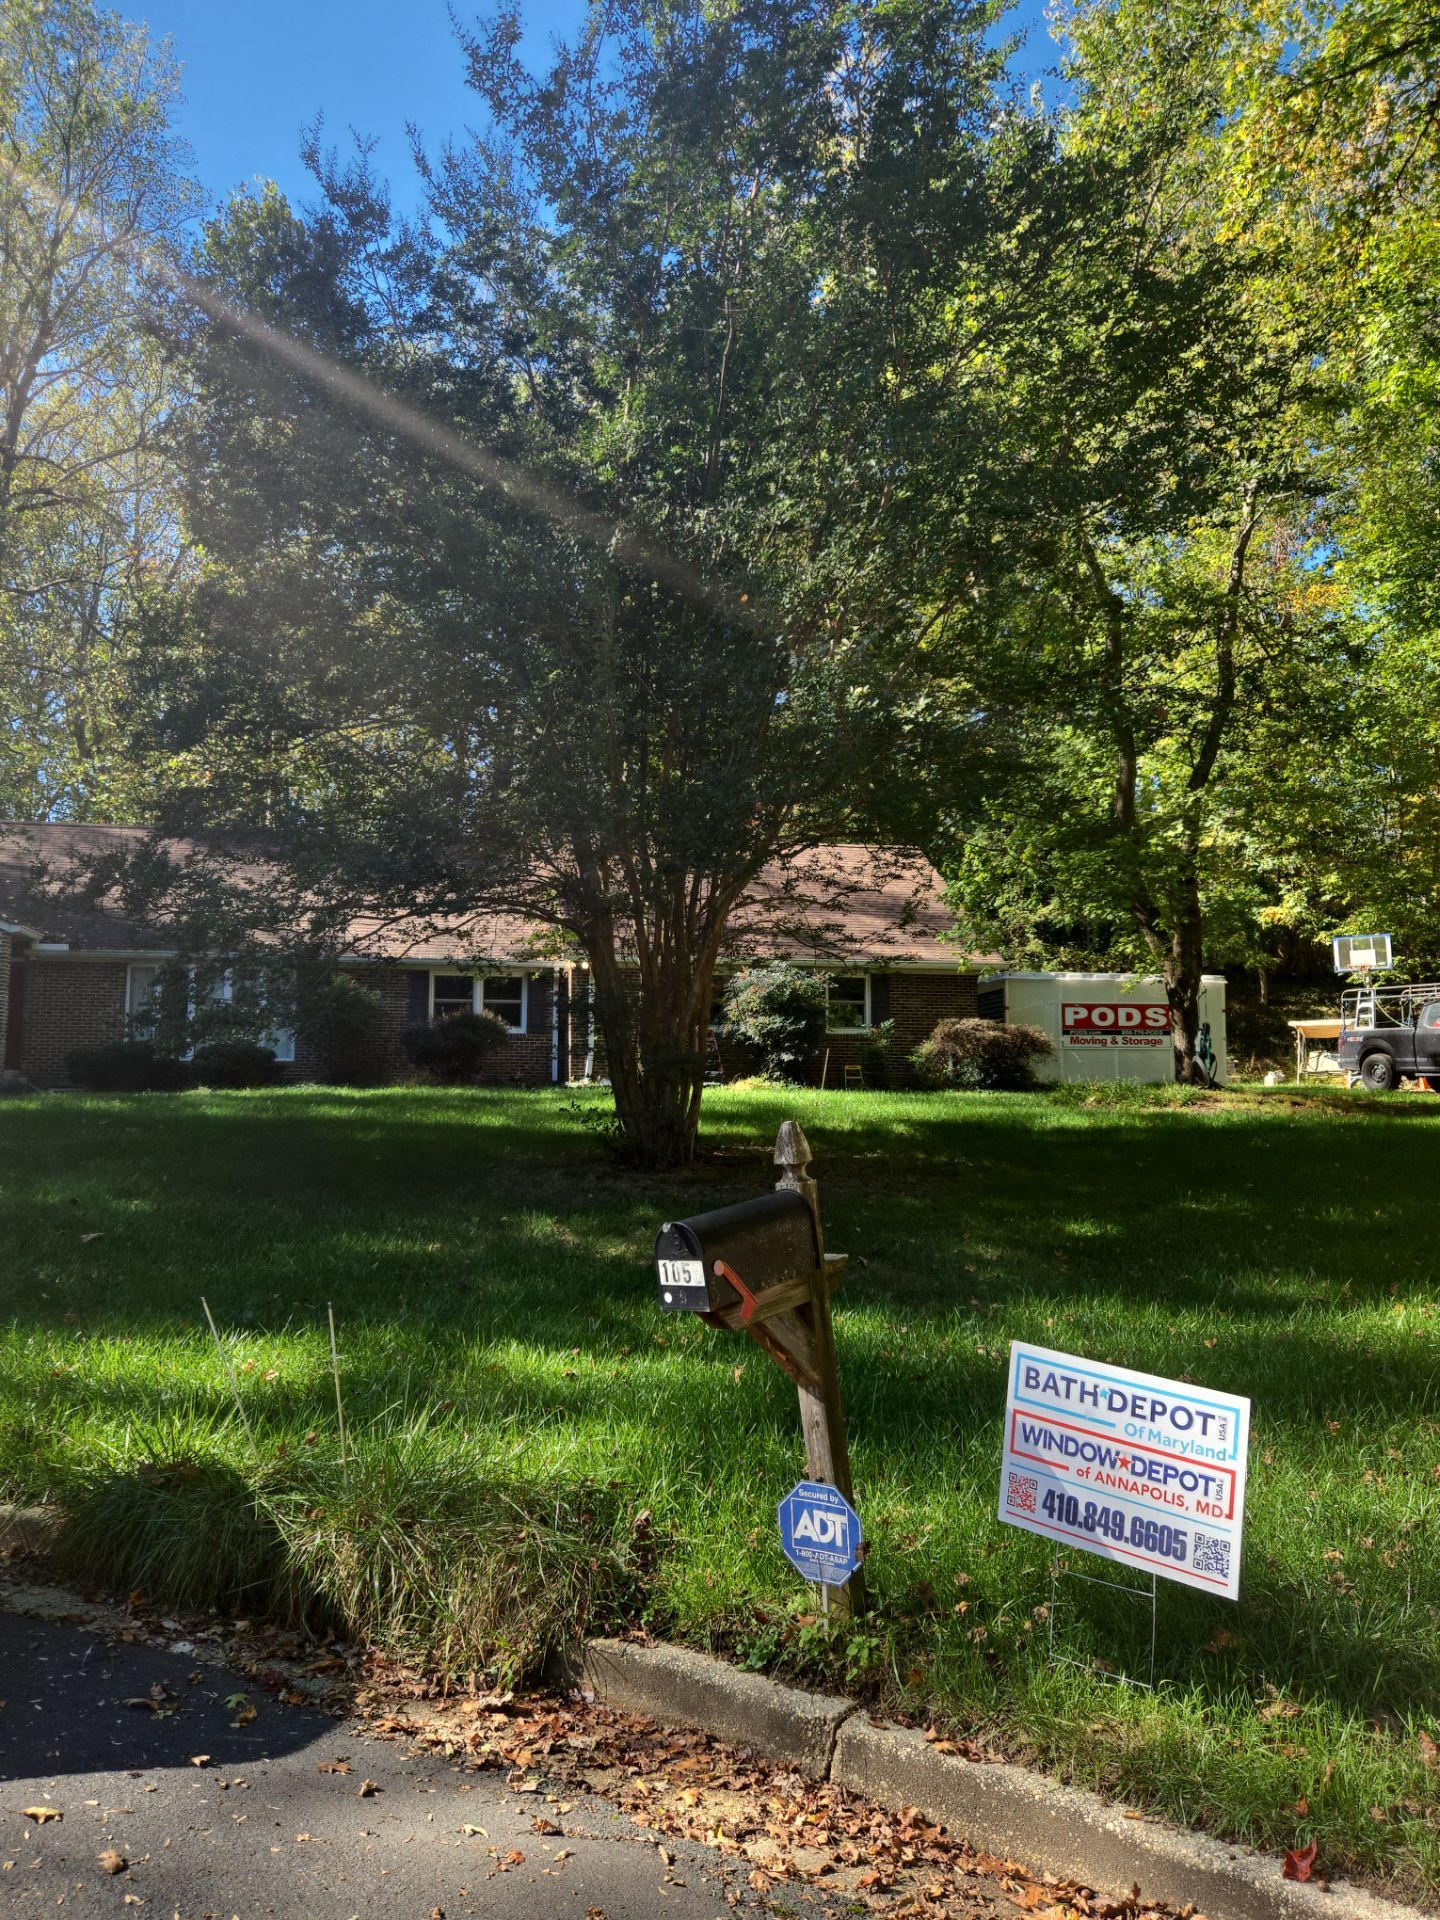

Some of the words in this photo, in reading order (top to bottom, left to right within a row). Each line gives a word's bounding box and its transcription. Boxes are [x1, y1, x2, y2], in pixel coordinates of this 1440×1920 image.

[1064, 1006, 1168, 1027] PODS
[1069, 1036, 1108, 1046] Moving
[1110, 1036, 1118, 1045] &
[1121, 1036, 1164, 1046] Storage
[1024, 1366, 1098, 1408] BATH
[1106, 1388, 1216, 1436] DEPOT
[1021, 1422, 1121, 1470] WINDOW
[1130, 1455, 1217, 1497] DEPOT
[1123, 1422, 1146, 1439] Of
[1148, 1429, 1227, 1463] Maryland
[798, 1488, 828, 1501] Secured
[829, 1493, 839, 1505] by
[1076, 1465, 1091, 1480] of
[1094, 1470, 1190, 1512] ANNAPOLIS,
[1195, 1500, 1224, 1519] MD
[793, 1508, 848, 1548] ADT
[1042, 1489, 1188, 1562] 410.849.6605
